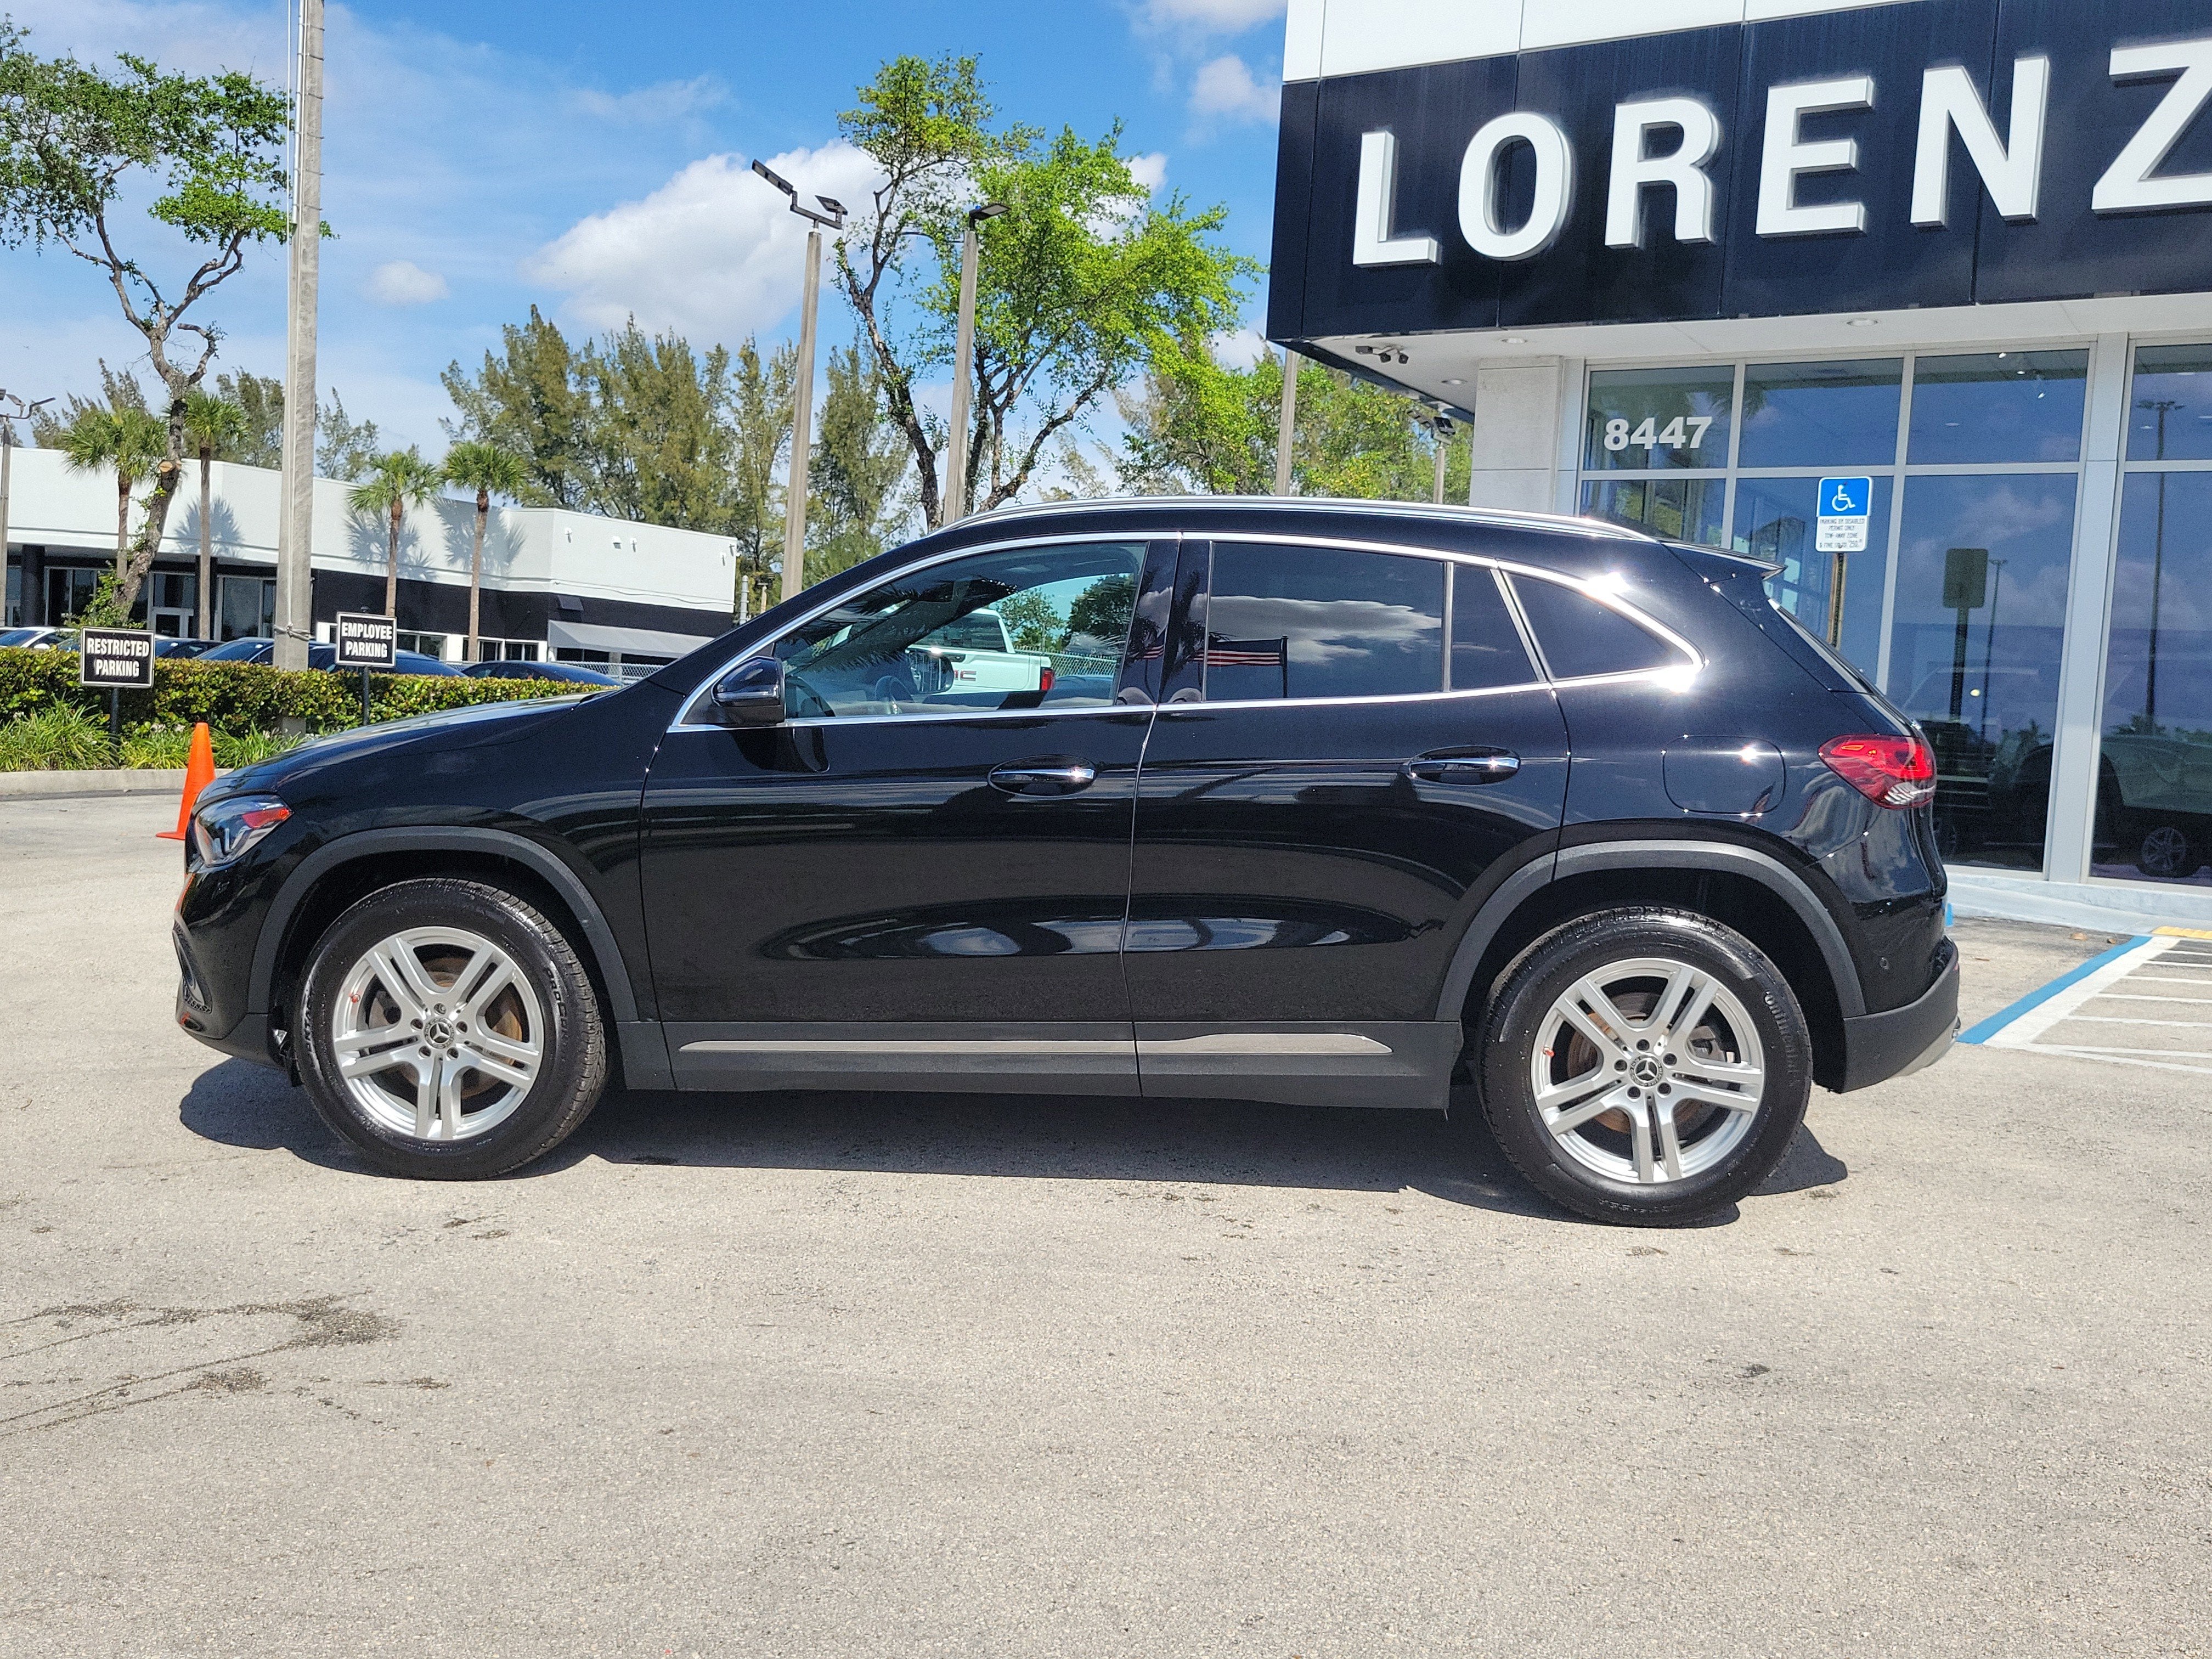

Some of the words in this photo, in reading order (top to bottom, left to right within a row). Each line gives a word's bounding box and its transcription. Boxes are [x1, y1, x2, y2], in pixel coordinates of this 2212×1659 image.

[1352, 38, 2212, 268] LORENZ
[1604, 416, 1712, 451] 8447
[341, 622, 392, 640] EMPLOYEE
[87, 637, 150, 657] RESTRICTED
[345, 641, 388, 658] PARKING
[95, 659, 140, 678] PARKING
